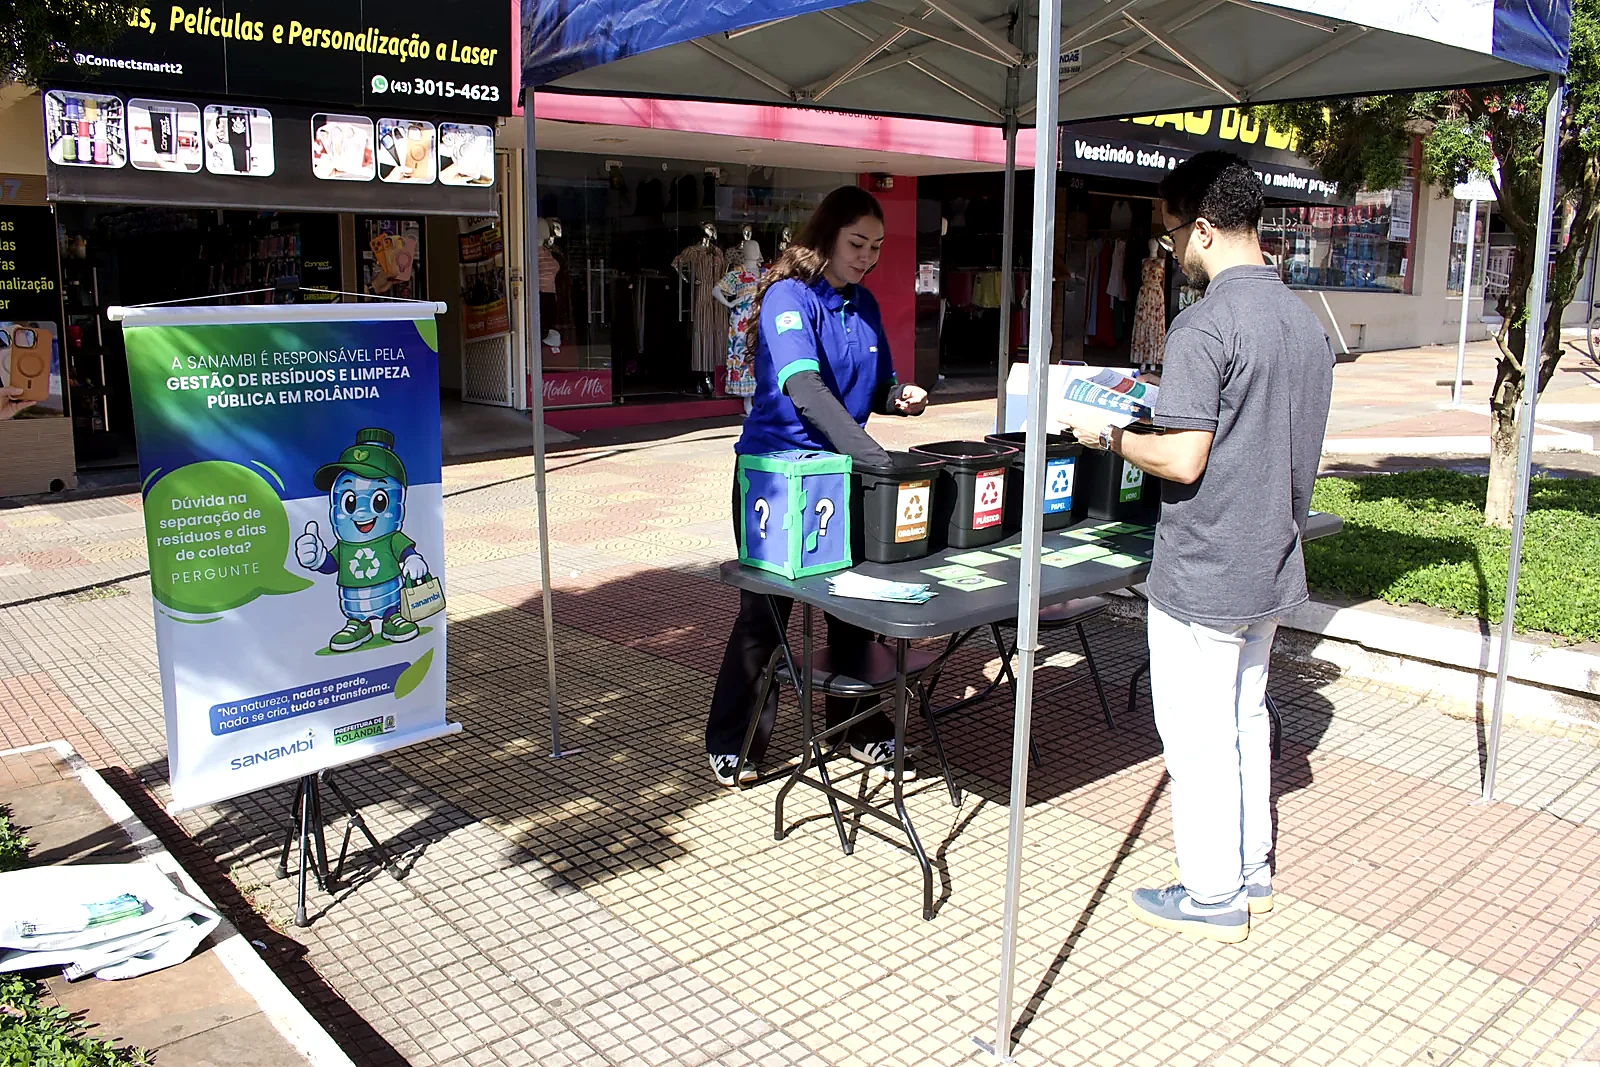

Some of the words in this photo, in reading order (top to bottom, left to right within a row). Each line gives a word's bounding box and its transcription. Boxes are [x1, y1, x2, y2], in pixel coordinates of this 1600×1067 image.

[170, 6, 263, 42] Películas
[272, 24, 284, 44] e
[288, 20, 430, 63] Personalização
[436, 42, 447, 61] a
[451, 40, 498, 66] Laser
[74, 53, 183, 75] @Connectsmartt2
[390, 79, 412, 95] (43)
[414, 78, 500, 102] 3015-4623
[1075, 140, 1134, 164] Vestindo
[1137, 145, 1166, 169] toda
[1168, 157, 1176, 170] a
[1264, 173, 1272, 185] o
[1273, 172, 1307, 190] melhor
[171, 356, 183, 370] A
[187, 353, 257, 369] SANAMBI
[261, 350, 268, 366] É
[273, 347, 371, 365] RESPONSÁVEL
[375, 348, 405, 361] PELA
[166, 371, 235, 391] GESTÃO
[238, 373, 258, 387] DE
[261, 368, 336, 386] RESÍDUOS
[339, 368, 347, 381] E
[350, 366, 410, 381] LIMPEZA
[575, 376, 605, 398] Mix
[207, 391, 275, 409] PÚBLICA
[279, 391, 301, 405] EM
[304, 385, 380, 402] ROLÂNDIA
[171, 495, 224, 510] Dúvida
[228, 494, 247, 504] na
[159, 510, 240, 531] separação
[243, 509, 261, 519] de
[754, 497, 770, 540] ?
[814, 497, 835, 537] ?
[976, 513, 1000, 525] PLÁSTICO
[157, 530, 221, 547] resíduos
[224, 529, 233, 539] e
[236, 525, 267, 537] dias
[175, 550, 194, 561] de
[198, 542, 252, 558] coleta?
[171, 562, 260, 584] PERGUNTE
[410, 592, 441, 610] sanambi
[240, 694, 291, 713] natureza,
[292, 687, 321, 701] nada
[322, 684, 335, 694] se
[335, 676, 369, 693] perde,
[219, 714, 249, 730] nada
[251, 712, 265, 722] se
[266, 706, 290, 720] cria,
[290, 700, 316, 713] tudo
[317, 697, 330, 707] se
[331, 683, 391, 704] transforma.
[334, 719, 373, 736] PREFEITURA
[373, 717, 383, 726] DE
[335, 724, 383, 745] ROLÂNDIA
